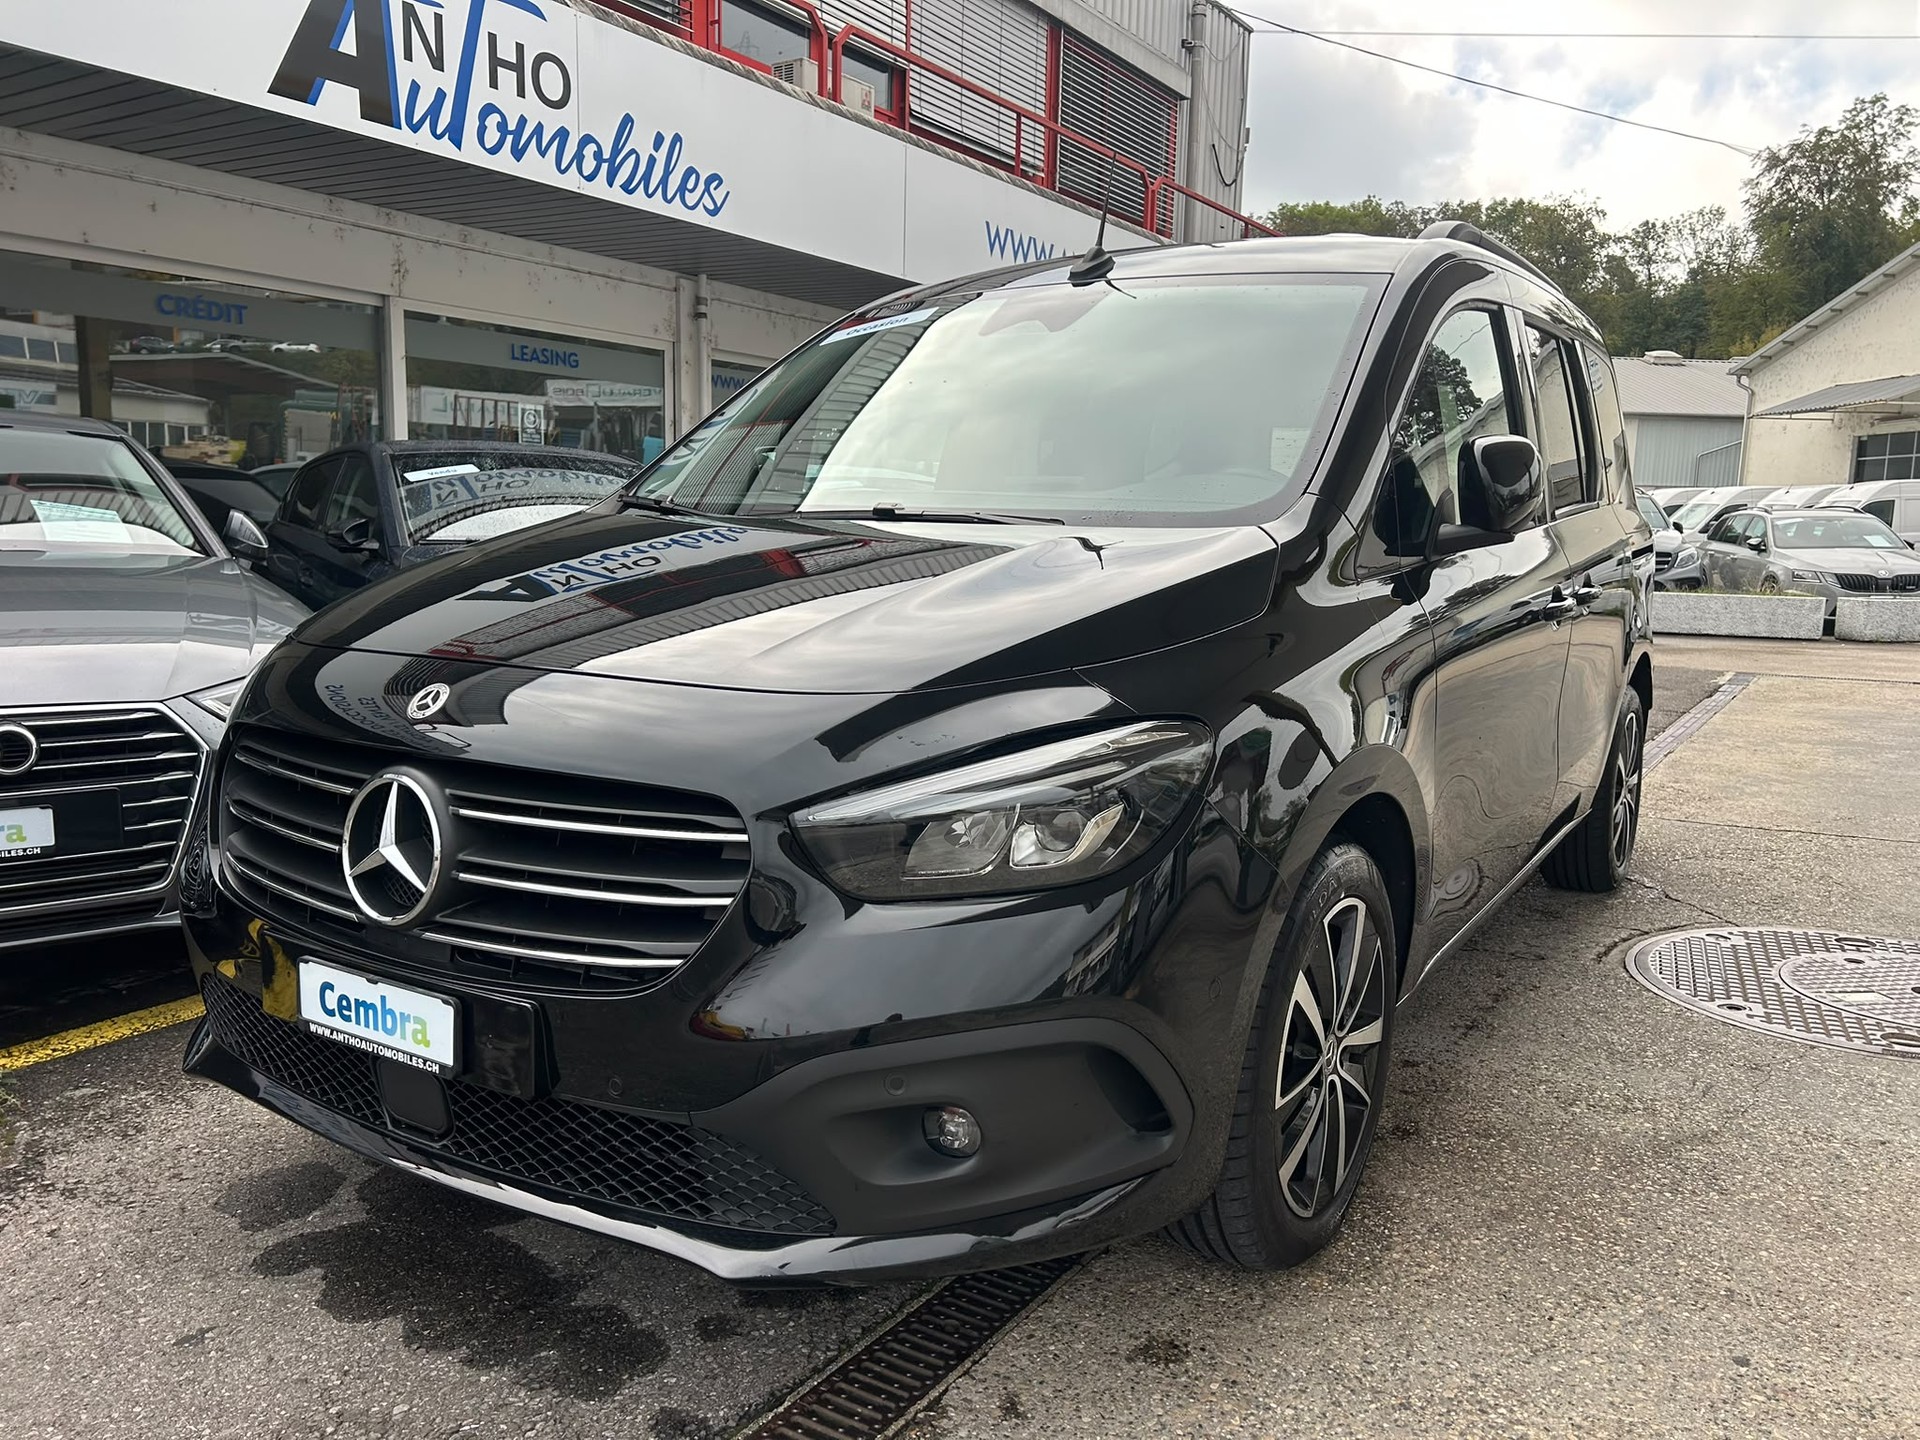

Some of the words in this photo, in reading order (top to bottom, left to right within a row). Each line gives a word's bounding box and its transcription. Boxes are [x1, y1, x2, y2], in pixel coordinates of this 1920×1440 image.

[985, 220, 1076, 264] WWW
[155, 294, 248, 325] CRÉDIT
[846, 317, 909, 336] Occasion
[511, 343, 580, 369] LEASING
[0, 847, 41, 858] ILES.CH
[319, 981, 431, 1048] Cembra
[309, 1022, 440, 1074] WWW.ANTHOAUTOMOBILES.CH
